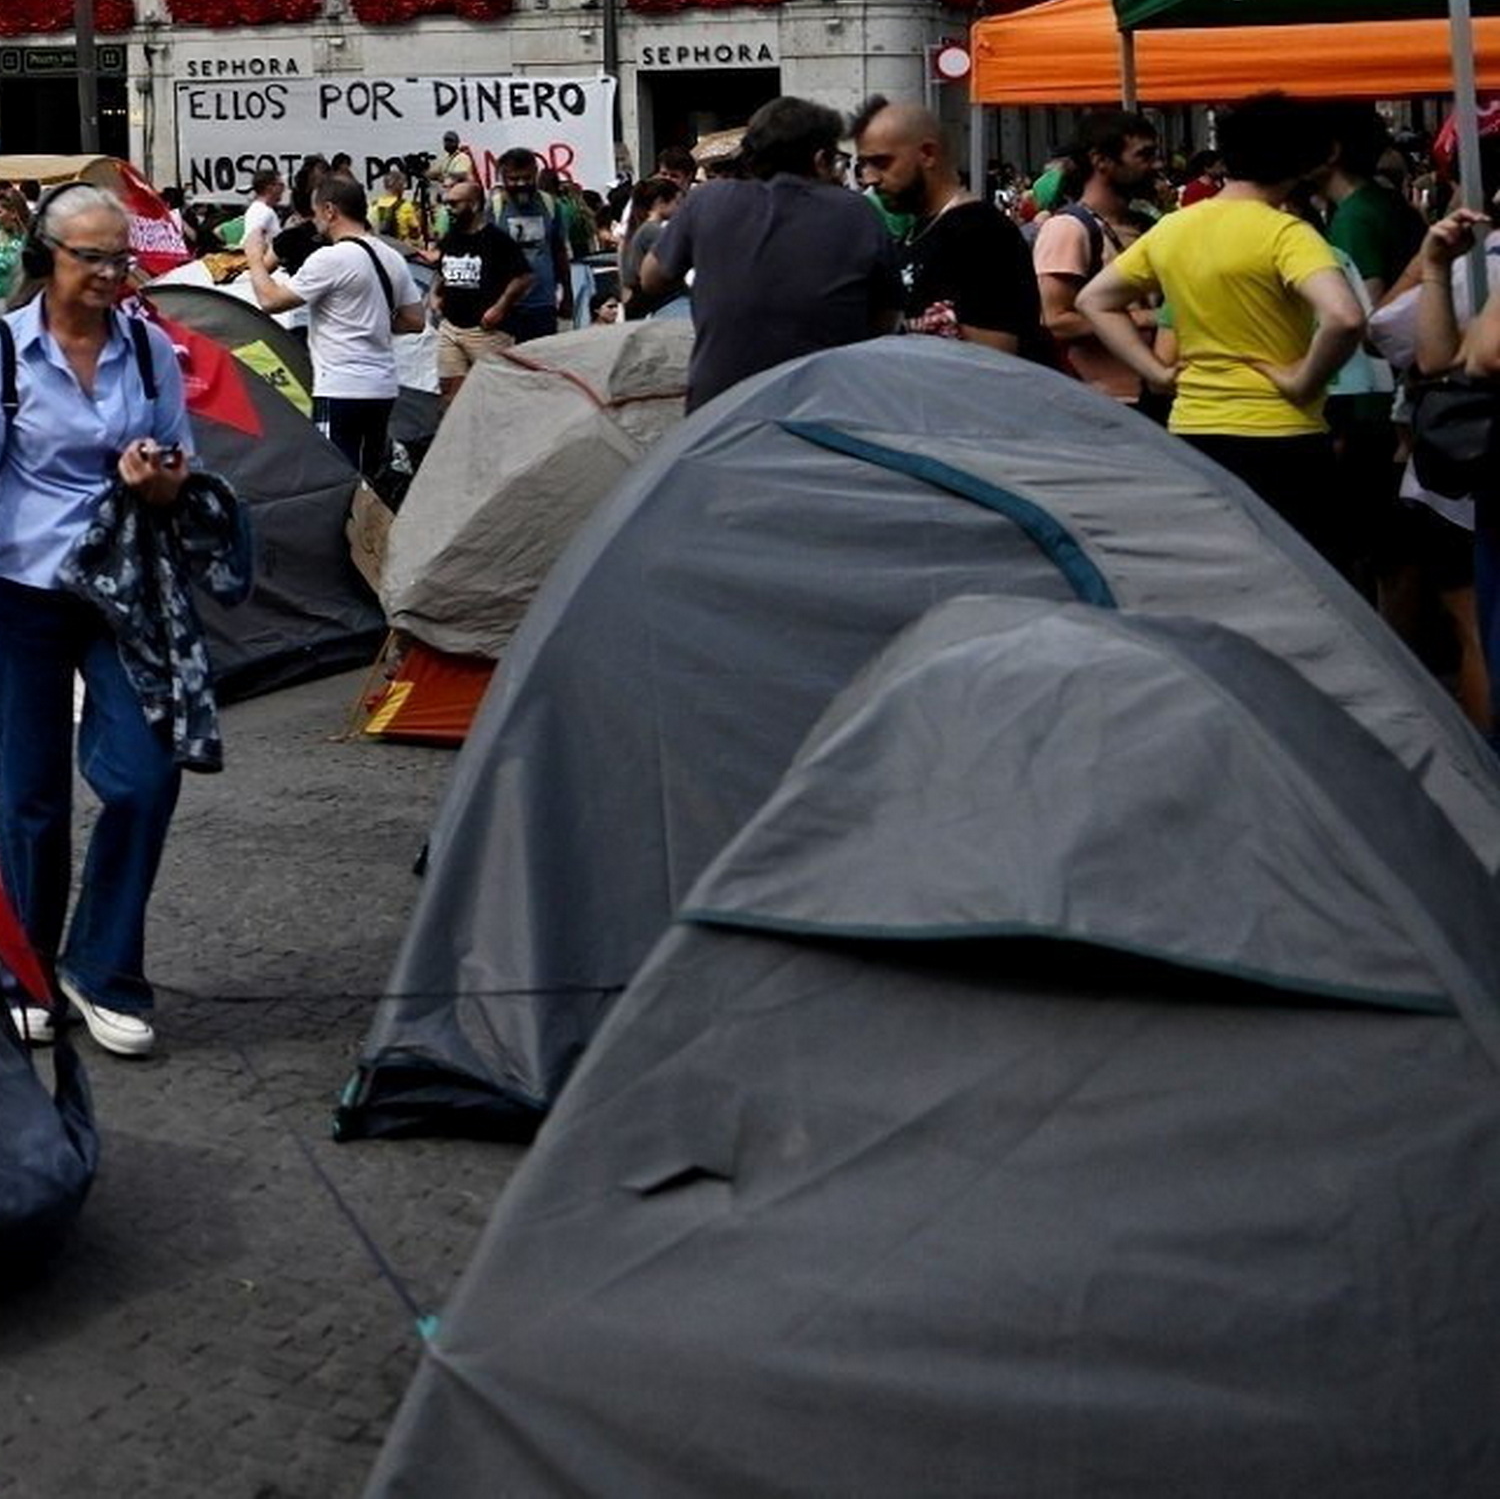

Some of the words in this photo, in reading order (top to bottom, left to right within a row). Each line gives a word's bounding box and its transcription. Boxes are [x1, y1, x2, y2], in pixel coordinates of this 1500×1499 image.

[642, 43, 774, 66] SEPHORA
[186, 57, 300, 77] SEPHORA
[187, 84, 288, 121] ELLOS
[320, 81, 403, 120] POR
